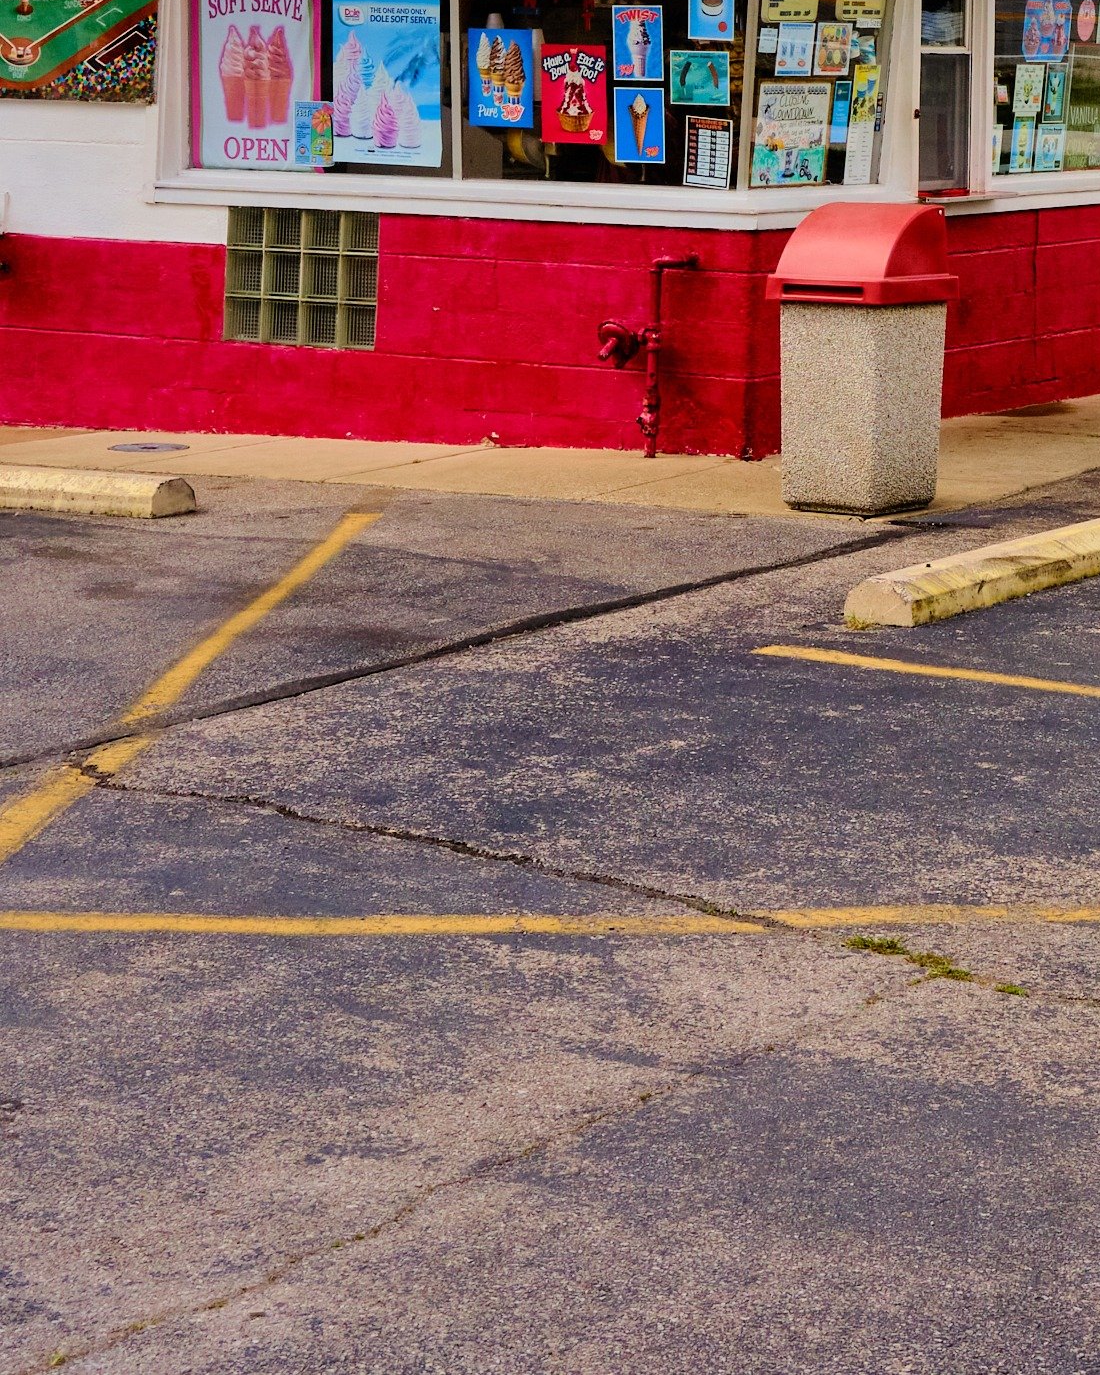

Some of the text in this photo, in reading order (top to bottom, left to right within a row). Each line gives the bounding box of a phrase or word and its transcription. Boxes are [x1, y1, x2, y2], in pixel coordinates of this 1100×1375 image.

[370, 14, 389, 23] DOLE
[390, 15, 409, 24] SOFT
[616, 8, 659, 24] TWIST
[543, 52, 571, 71] Have a
[577, 52, 605, 71] Eat it
[550, 63, 569, 81] Bowl
[580, 65, 598, 82] Too!
[779, 93, 810, 109] CLOSING
[477, 103, 498, 118] Pure
[1070, 105, 1099, 125] VANILLA
[690, 117, 729, 127] BUSINESS
[695, 123, 723, 131] HOURS
[223, 136, 290, 162] OPEN
